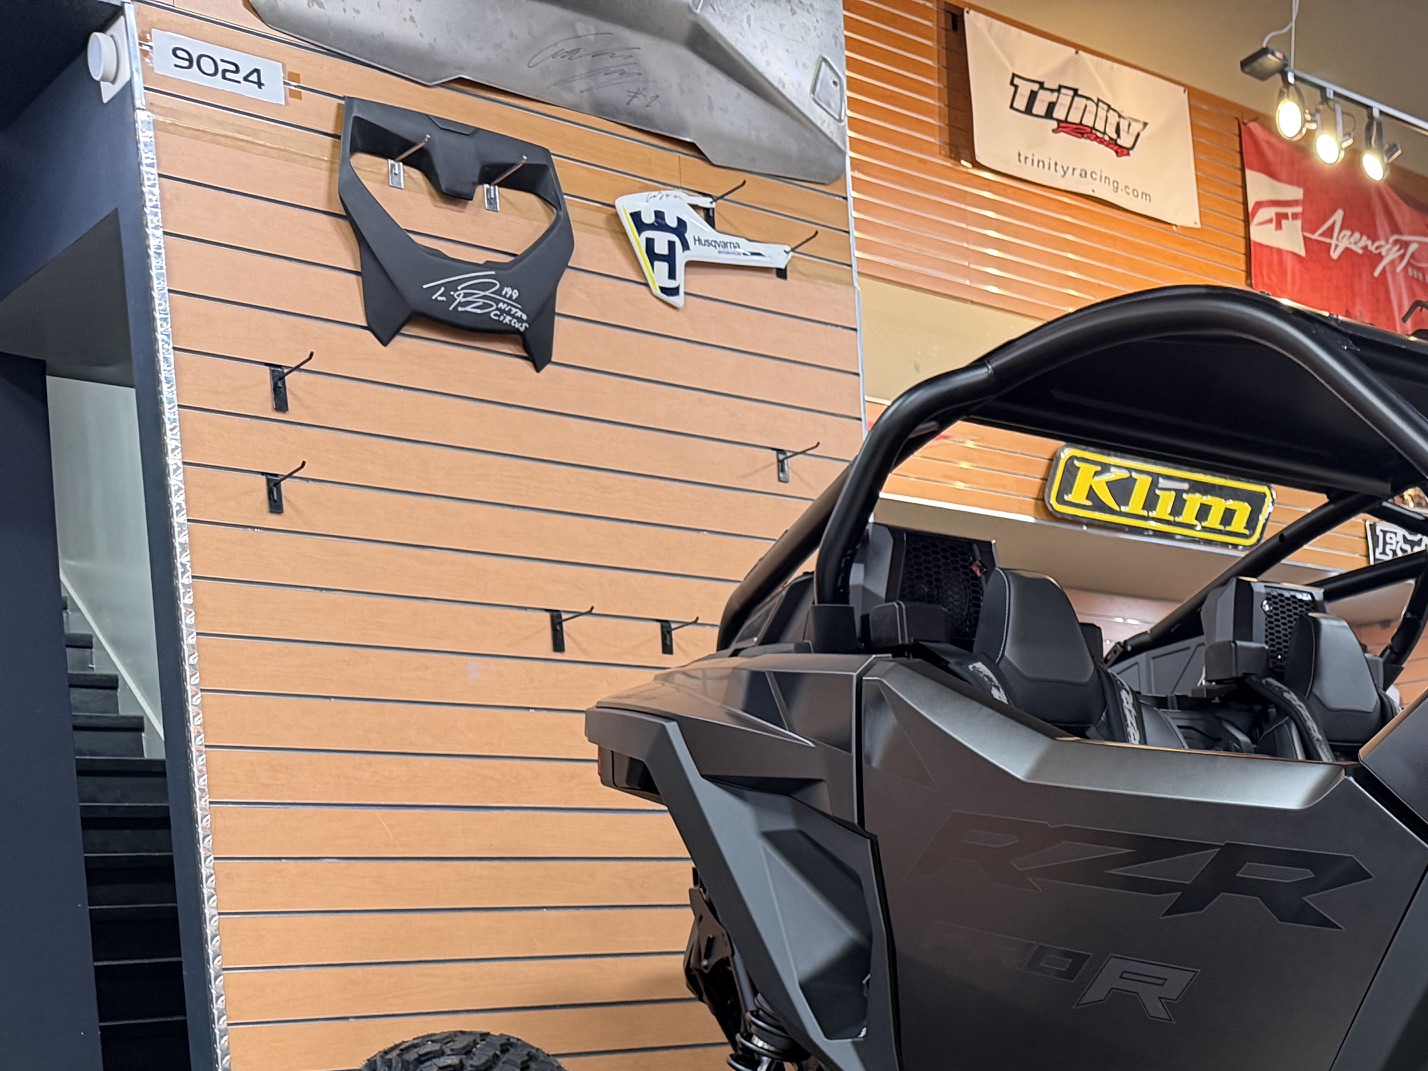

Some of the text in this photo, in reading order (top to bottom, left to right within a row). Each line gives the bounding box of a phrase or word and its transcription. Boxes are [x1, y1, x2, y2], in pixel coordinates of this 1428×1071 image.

[171, 46, 266, 90] 9024
[1009, 73, 1149, 151] Trinity
[1017, 151, 1153, 204] trinityracing.com
[693, 234, 741, 250] Husqvarna
[1063, 459, 1252, 535] Klim
[903, 810, 1375, 931] RZR
[1073, 953, 1201, 1024] R
